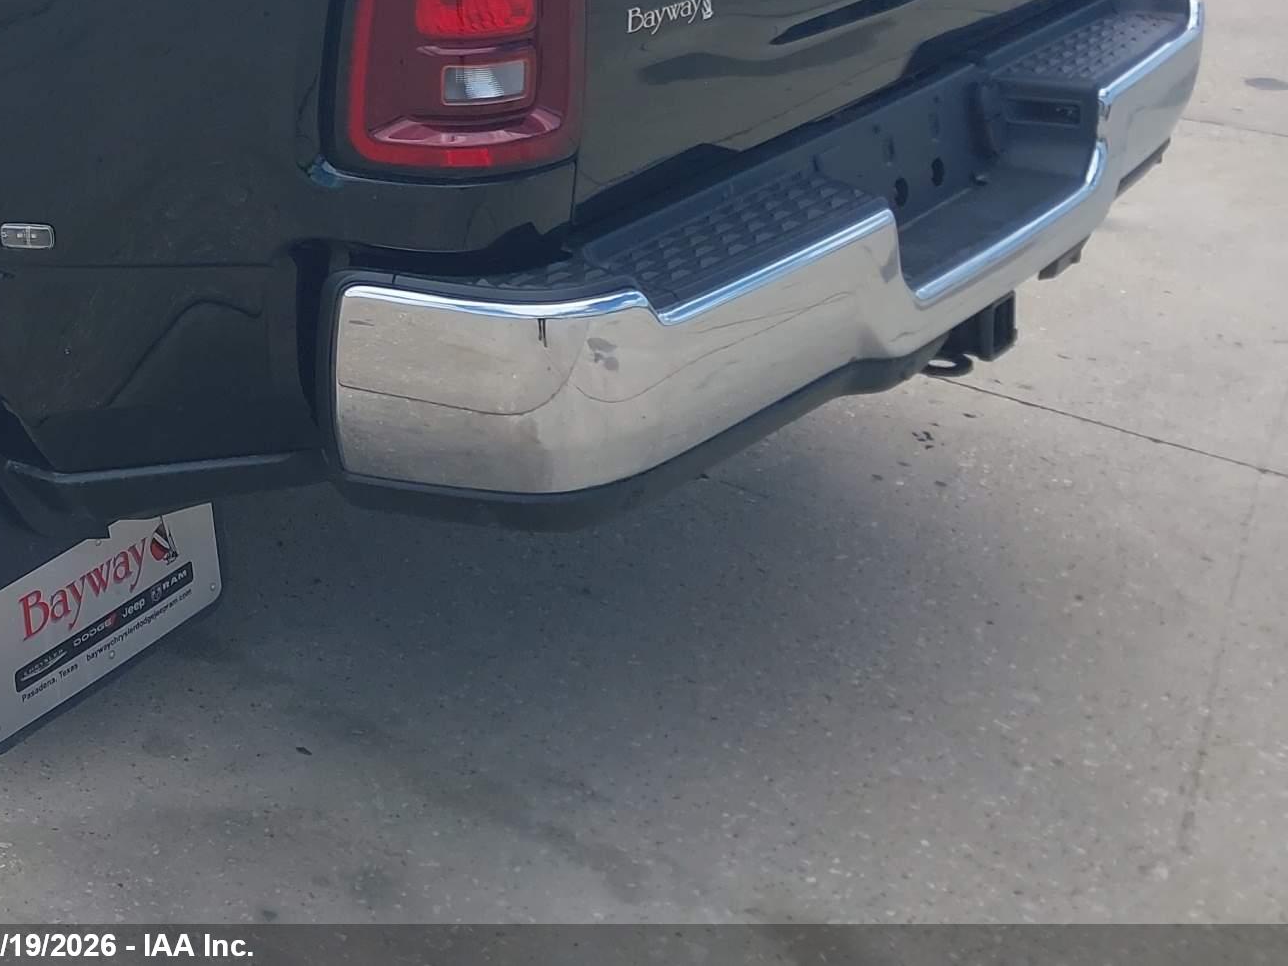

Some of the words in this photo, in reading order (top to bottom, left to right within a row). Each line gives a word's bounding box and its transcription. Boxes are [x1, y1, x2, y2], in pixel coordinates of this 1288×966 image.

[18, 537, 147, 641] Bayway
[122, 598, 145, 618] Jeep
[163, 570, 187, 590] RAM
[21, 677, 58, 703] Pasadena,
[58, 663, 79, 679] Texas
